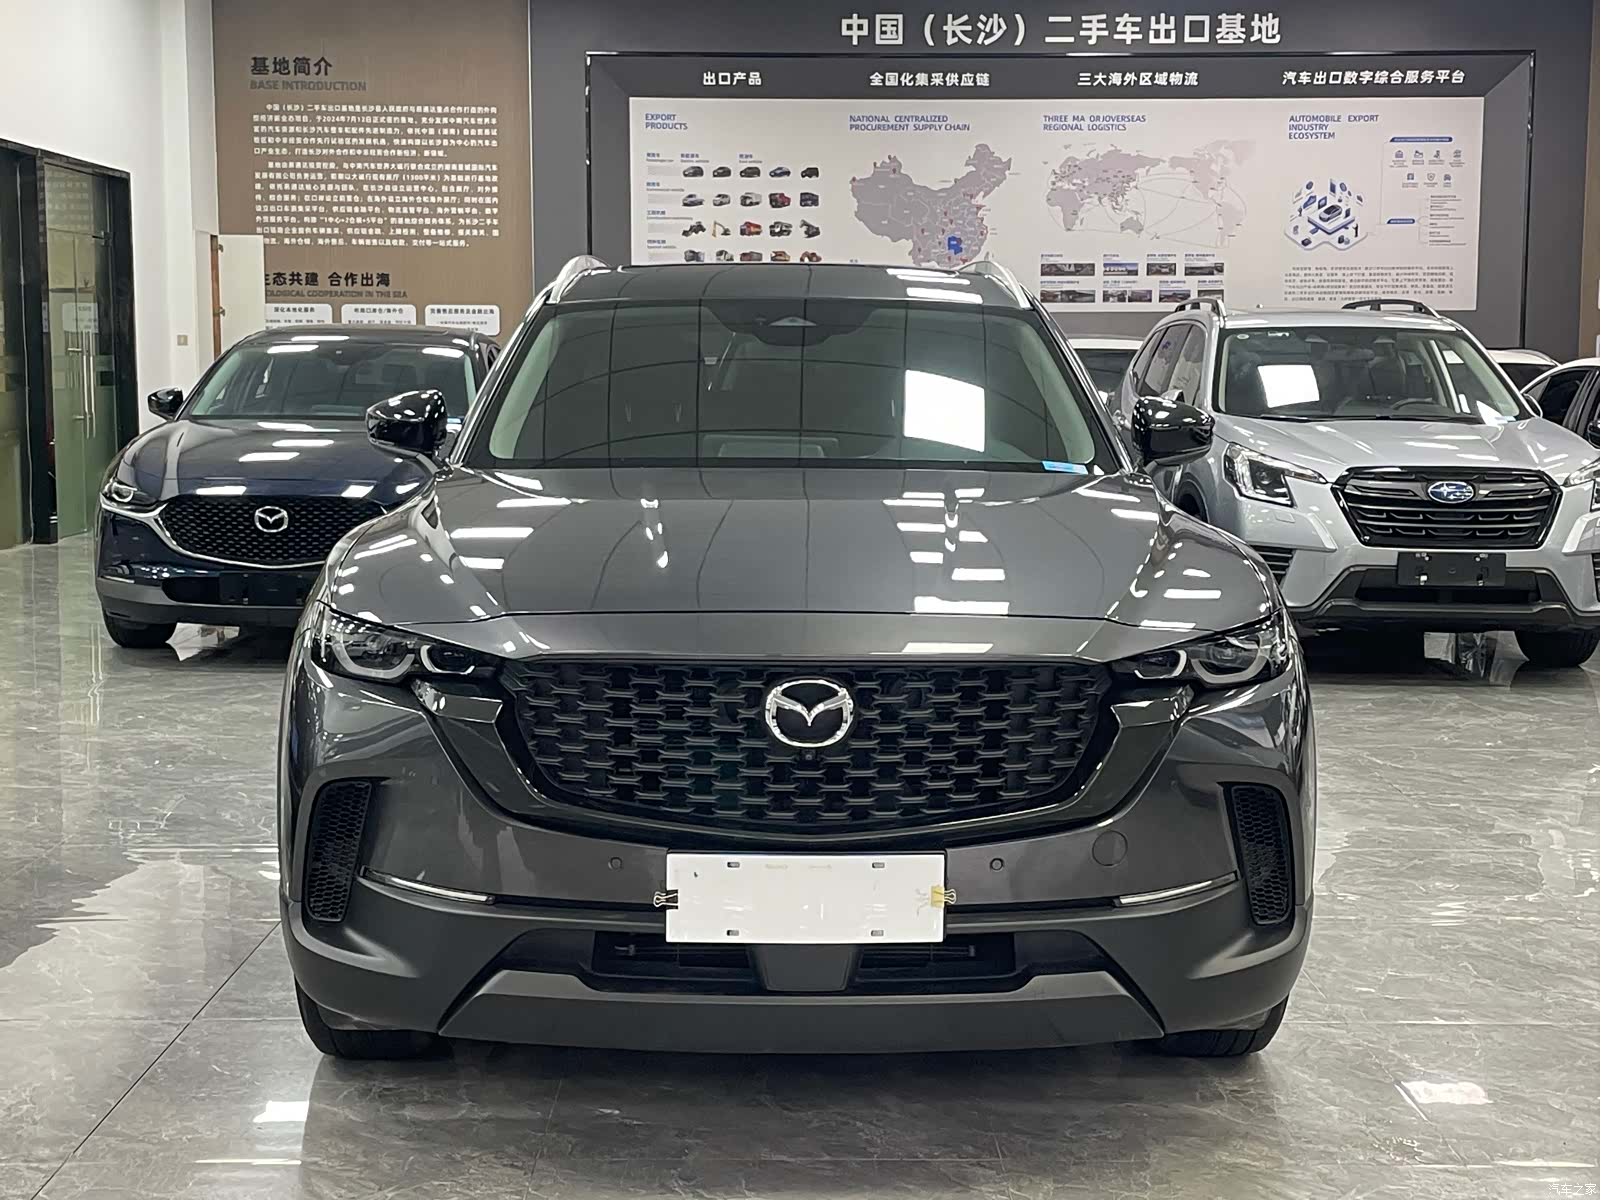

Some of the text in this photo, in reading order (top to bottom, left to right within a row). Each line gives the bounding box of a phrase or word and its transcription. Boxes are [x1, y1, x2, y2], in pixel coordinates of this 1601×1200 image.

[841, 13, 1281, 46] 中国（长沙）二手车出口基地
[250, 56, 333, 76] 基地简介
[703, 71, 762, 86] 出口产品
[869, 71, 990, 87] 全国化集采供应链
[1077, 71, 1199, 87] 三大海外区域物流
[1282, 70, 1465, 85] 汽车出口数字综合服务平台
[250, 80, 367, 91] BASE INTRODUCTION
[645, 113, 676, 121] EXPORT
[645, 122, 688, 130] PRODUCTS
[328, 272, 391, 287] 合作出海
[265, 289, 408, 298] OLOGICAL COOPERATION IN THE SEA
